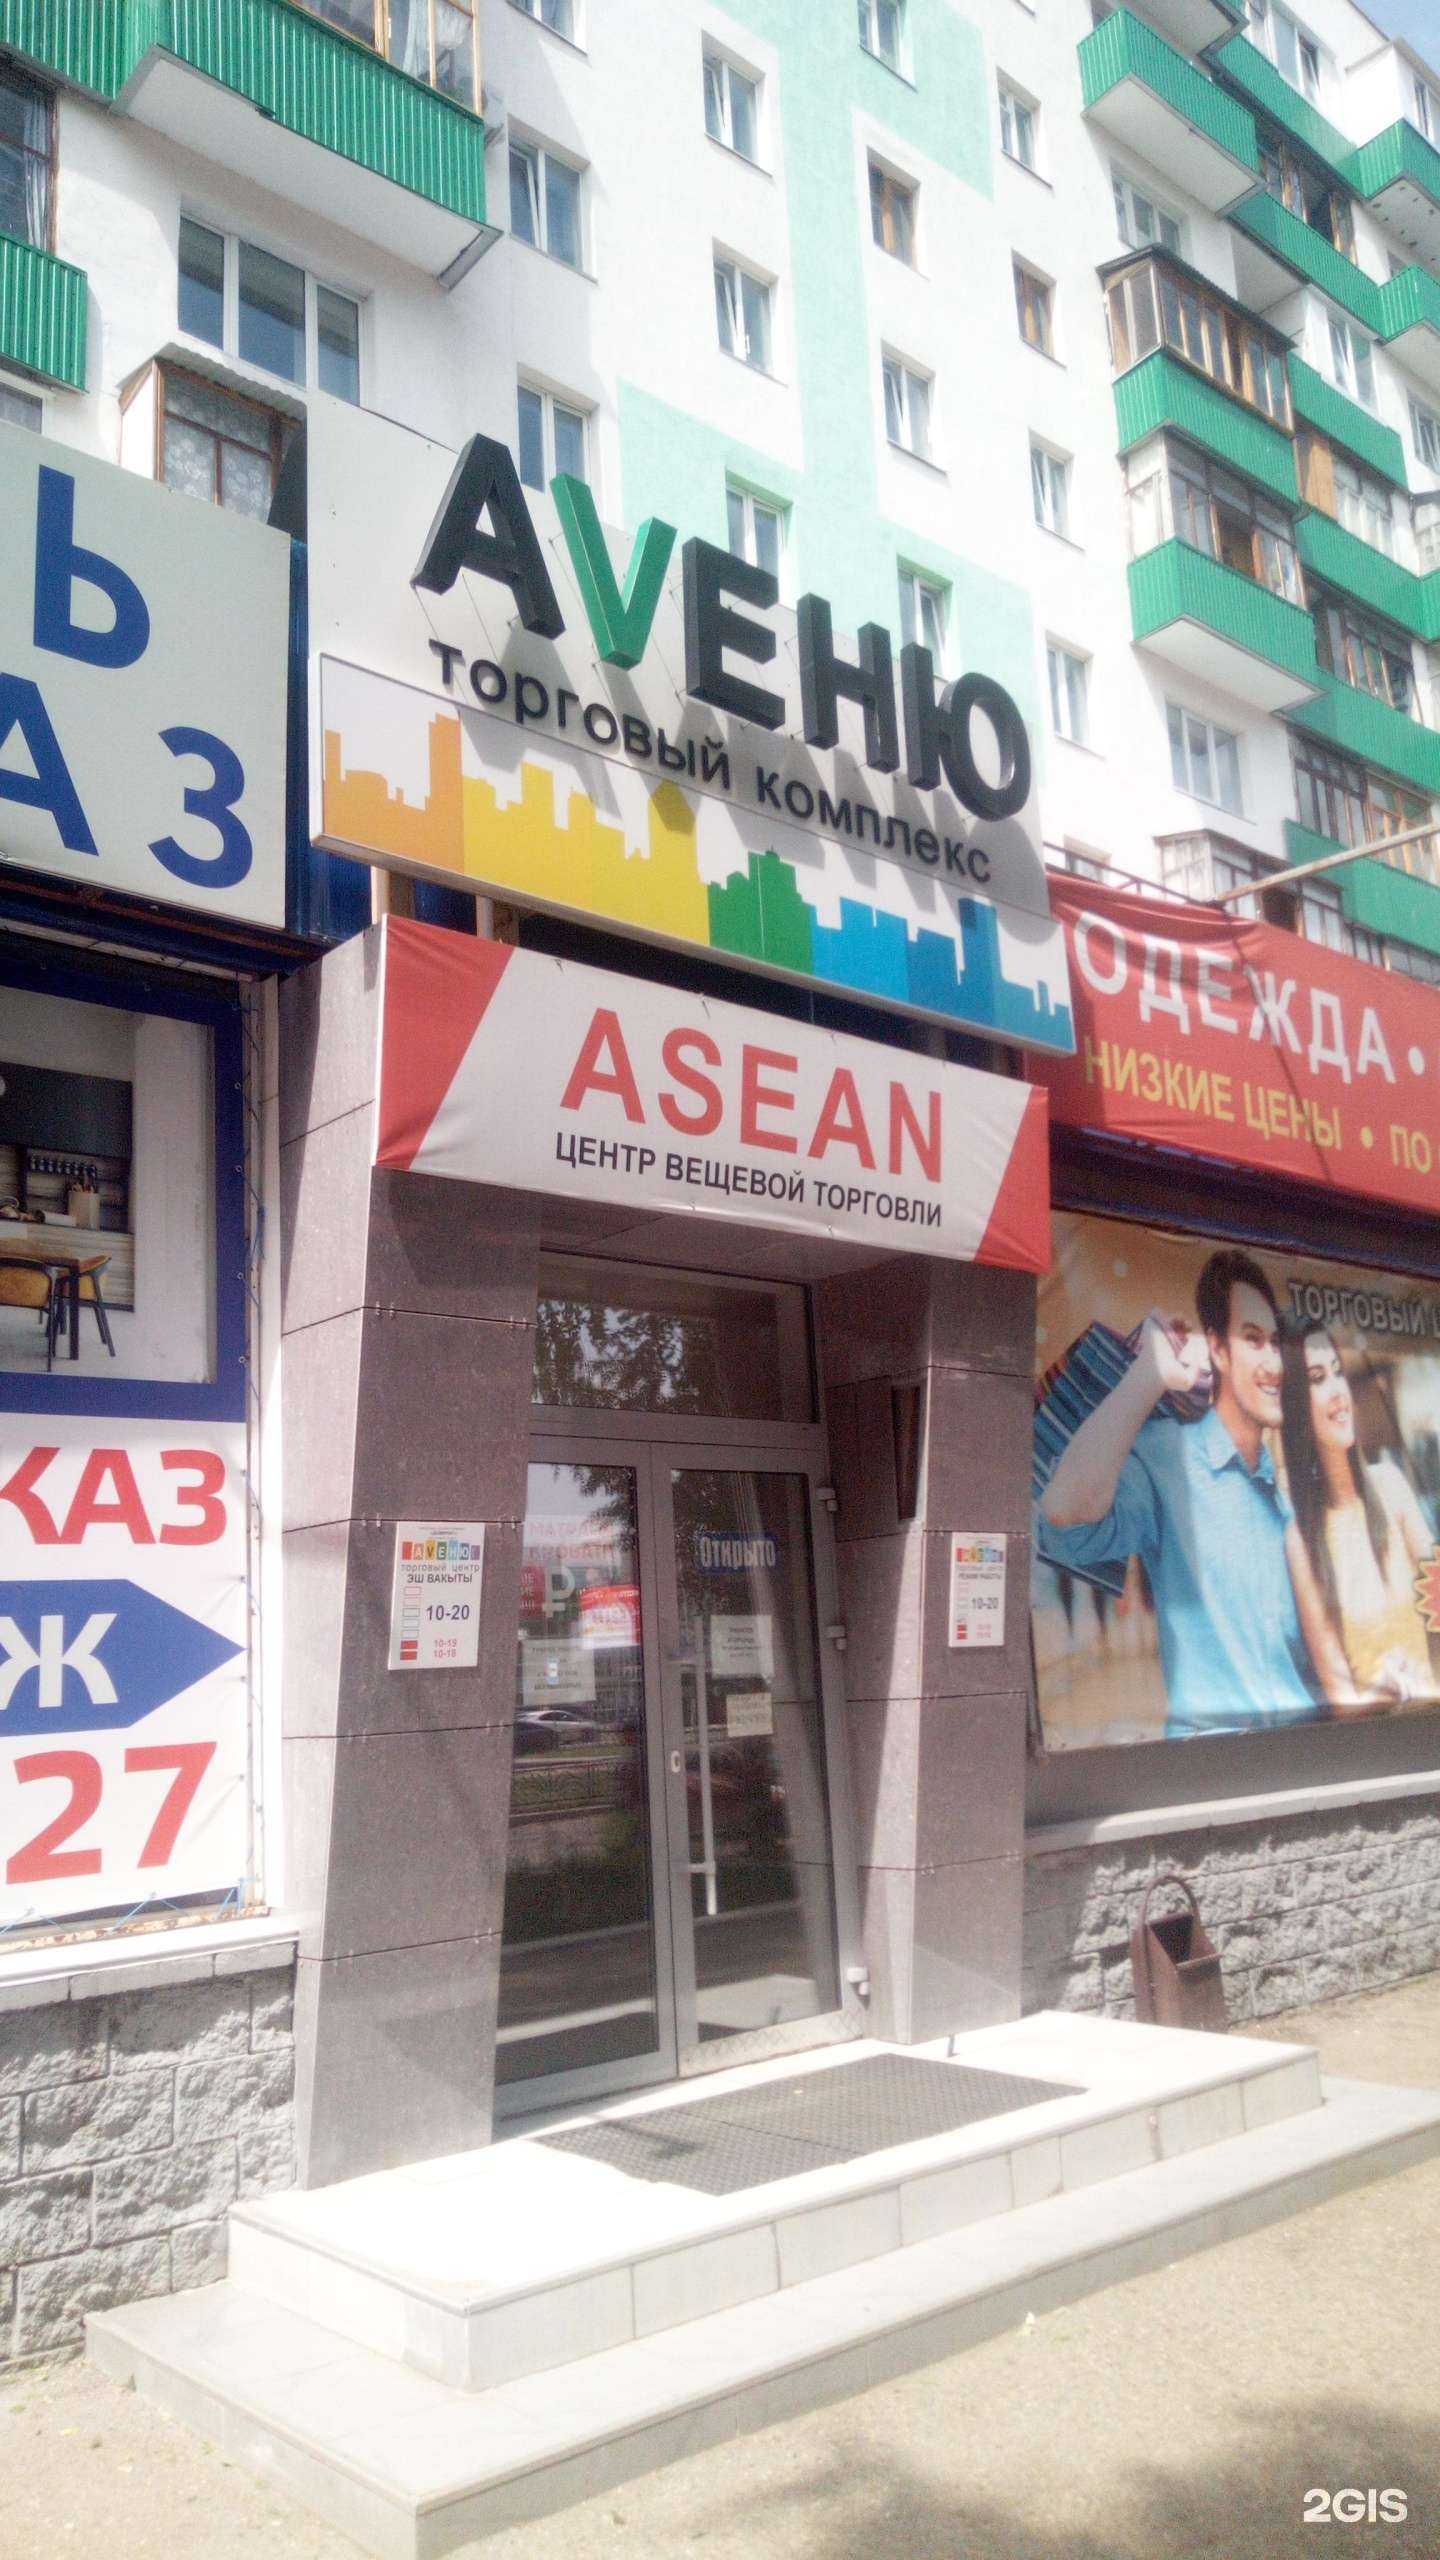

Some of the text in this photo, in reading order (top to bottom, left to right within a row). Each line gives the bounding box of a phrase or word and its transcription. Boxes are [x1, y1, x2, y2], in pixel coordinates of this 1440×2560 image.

[429, 638, 991, 884] торговый комплекс
[1074, 911, 1396, 1084] ОДЕЖДА
[560, 1008, 941, 1183] ASEAN
[1084, 1036, 1235, 1123] НИЗКИЕ
[1243, 1082, 1341, 1151] ЦЕНЫ
[556, 1131, 941, 1227] ЦЕНТР ВЕЩЕВОЙ ТОРГОВЛИ
[426, 1604, 470, 1621] 10-20
[6, 1741, 217, 1884] 27
